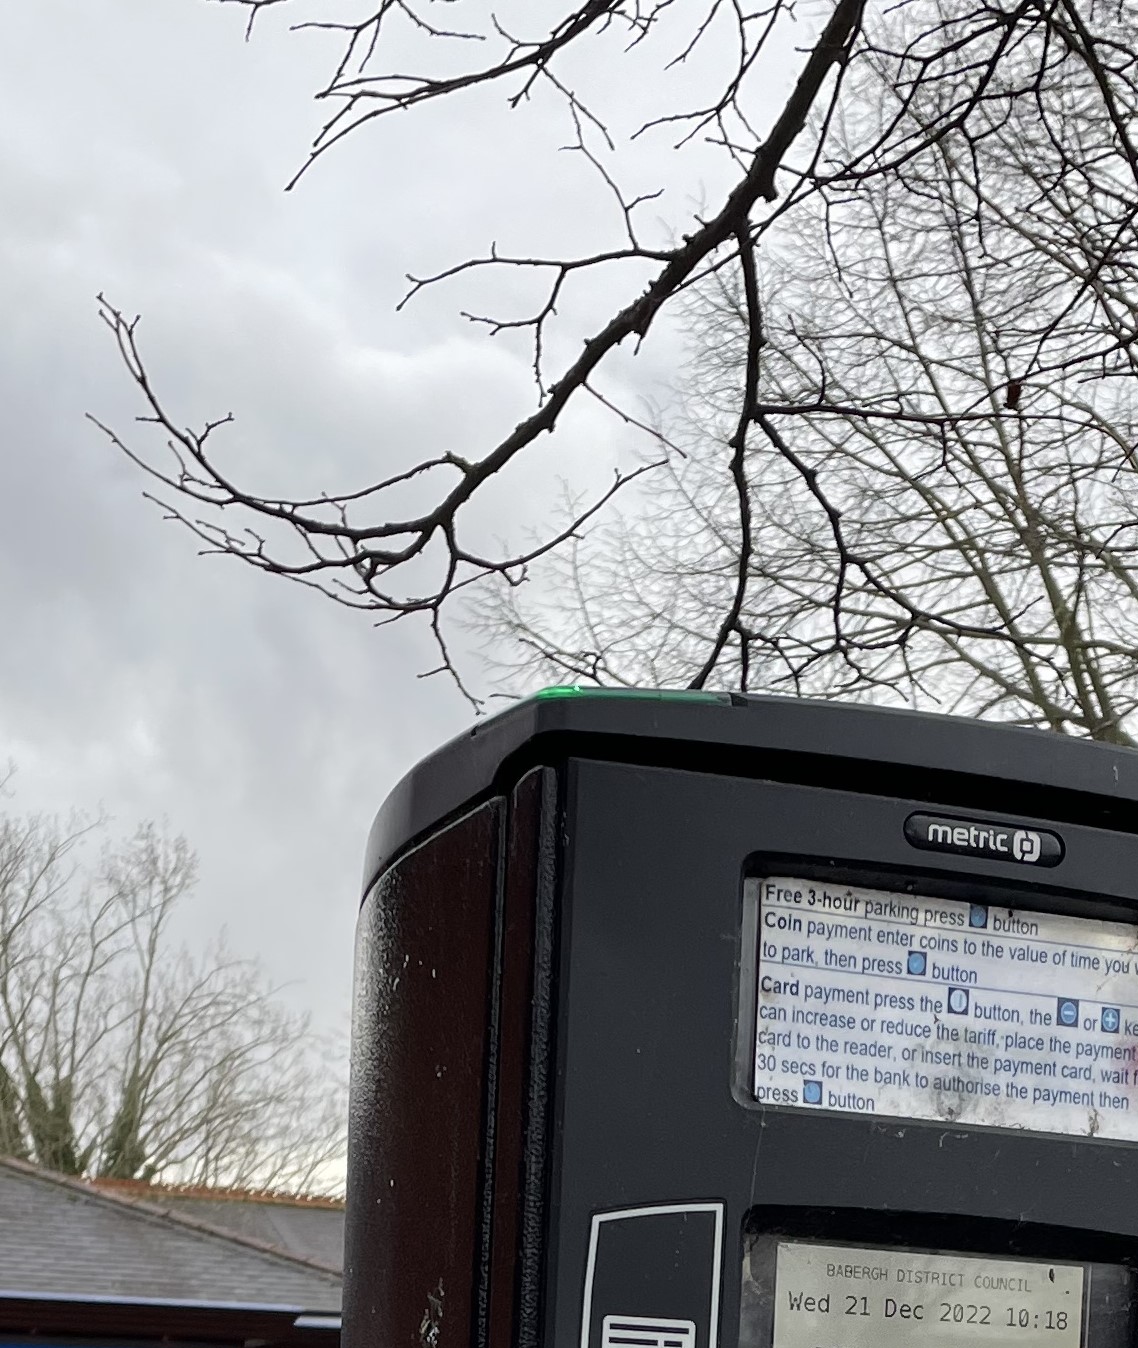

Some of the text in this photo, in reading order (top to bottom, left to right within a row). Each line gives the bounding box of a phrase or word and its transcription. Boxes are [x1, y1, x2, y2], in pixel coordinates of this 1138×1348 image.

[928, 823, 1008, 853] metric
[765, 883, 1038, 936] Free 3-hour parking press button
[762, 940, 978, 985] to park, then press button
[764, 911, 802, 933] Coin
[806, 920, 872, 942] payment
[876, 929, 916, 948] enter
[919, 935, 958, 953] coins
[963, 938, 977, 956] to
[981, 940, 1004, 959] the
[1008, 944, 1048, 964] value
[1052, 949, 1068, 967] of
[1070, 951, 1100, 971] time
[1104, 958, 1130, 976] you
[759, 977, 800, 997] Card
[804, 984, 870, 1006] payment
[874, 992, 915, 1011] press
[919, 995, 943, 1014] the
[974, 1001, 1024, 1026] button,
[1029, 1008, 1052, 1027] the
[1083, 1017, 1098, 1031] or
[757, 1083, 875, 1112] press button
[826, 1263, 1032, 1293] BABERGH DISTRICT COUNCIL
[788, 1290, 1068, 1331] Wed 21 Dec 2022 10:18
